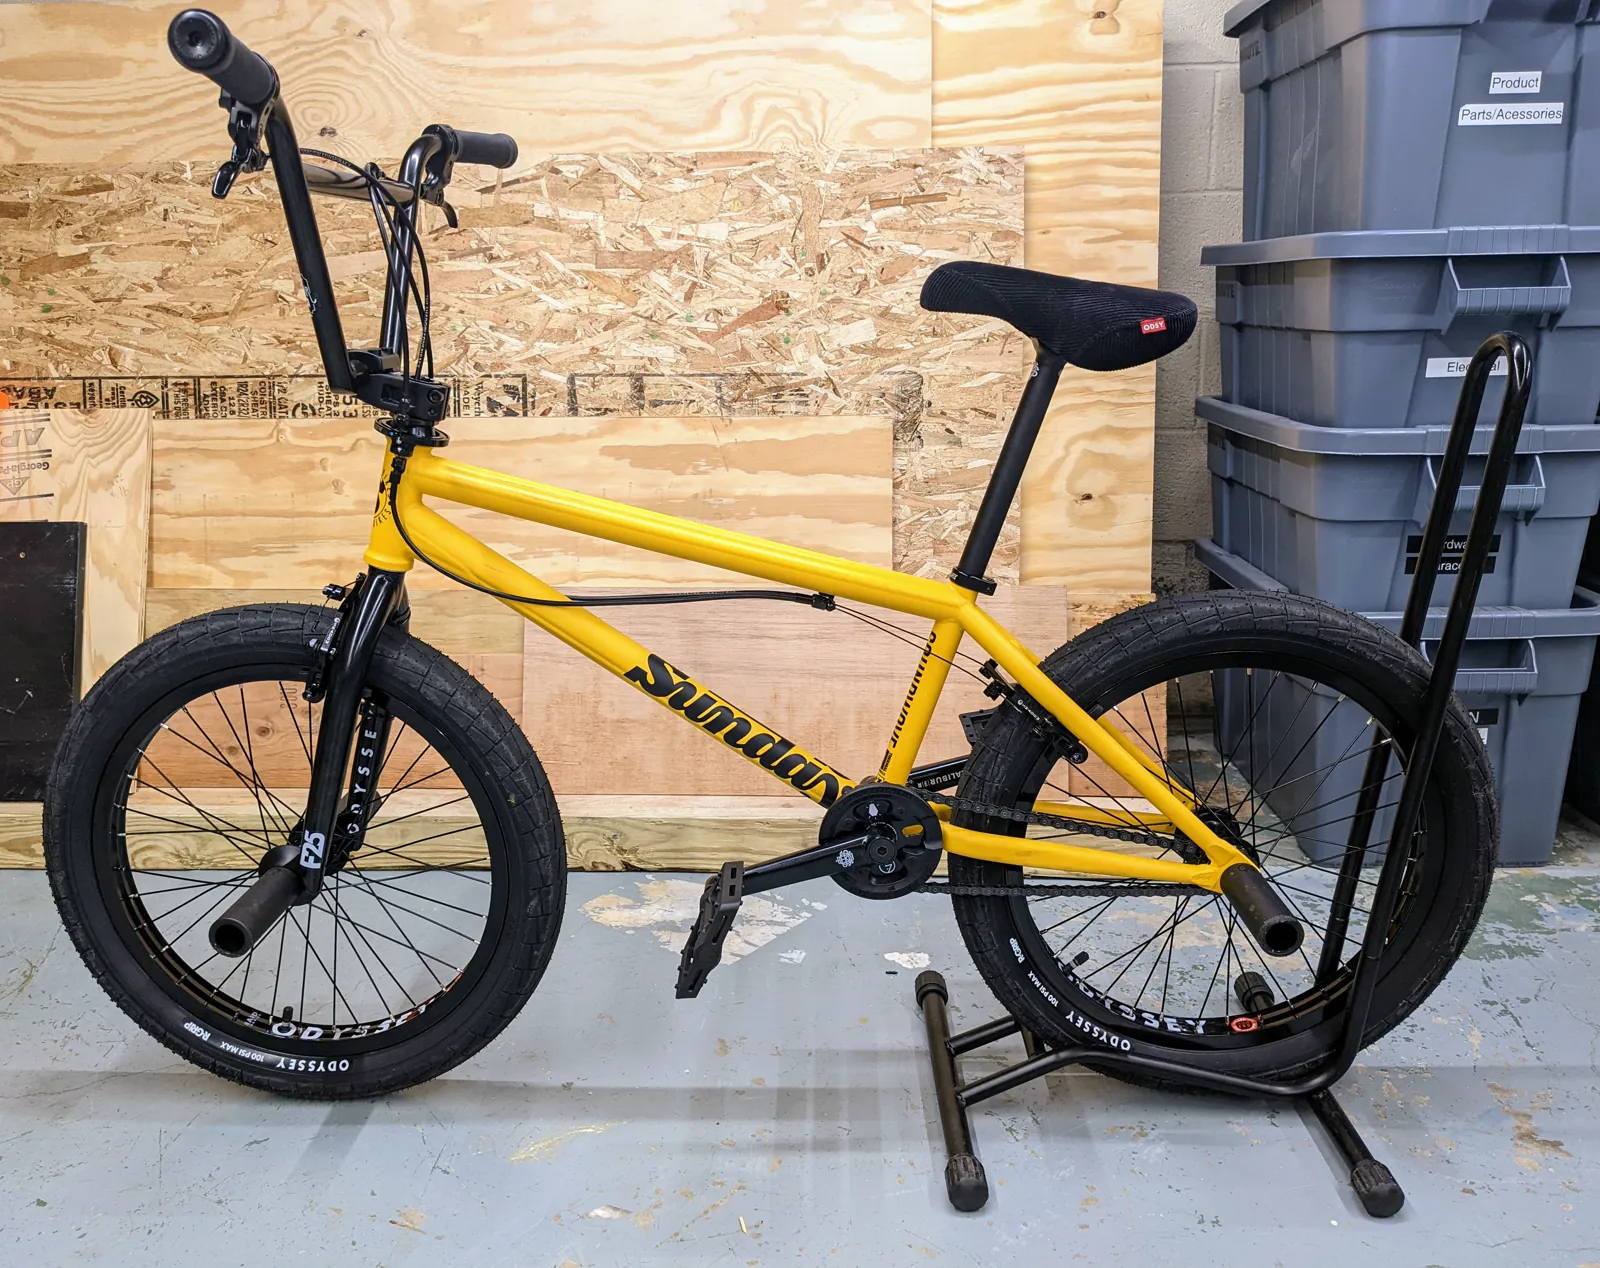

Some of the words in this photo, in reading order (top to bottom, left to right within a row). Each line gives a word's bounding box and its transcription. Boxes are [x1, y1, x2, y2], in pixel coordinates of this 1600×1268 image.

[1492, 76, 1539, 89] Product
[1461, 108, 1562, 121] Parts/Acessories
[1143, 322, 1163, 331] ODSY
[299, 830, 325, 870] F25
[1027, 970, 1041, 987] MAX
[1039, 984, 1050, 997] PSI
[1048, 994, 1059, 1008] 100
[1065, 1010, 1131, 1051] ODYSSEY
[219, 1040, 240, 1055] MAX
[238, 1048, 252, 1059] PSI
[251, 1051, 265, 1063] 100
[276, 1057, 350, 1073] ODYSSEY
